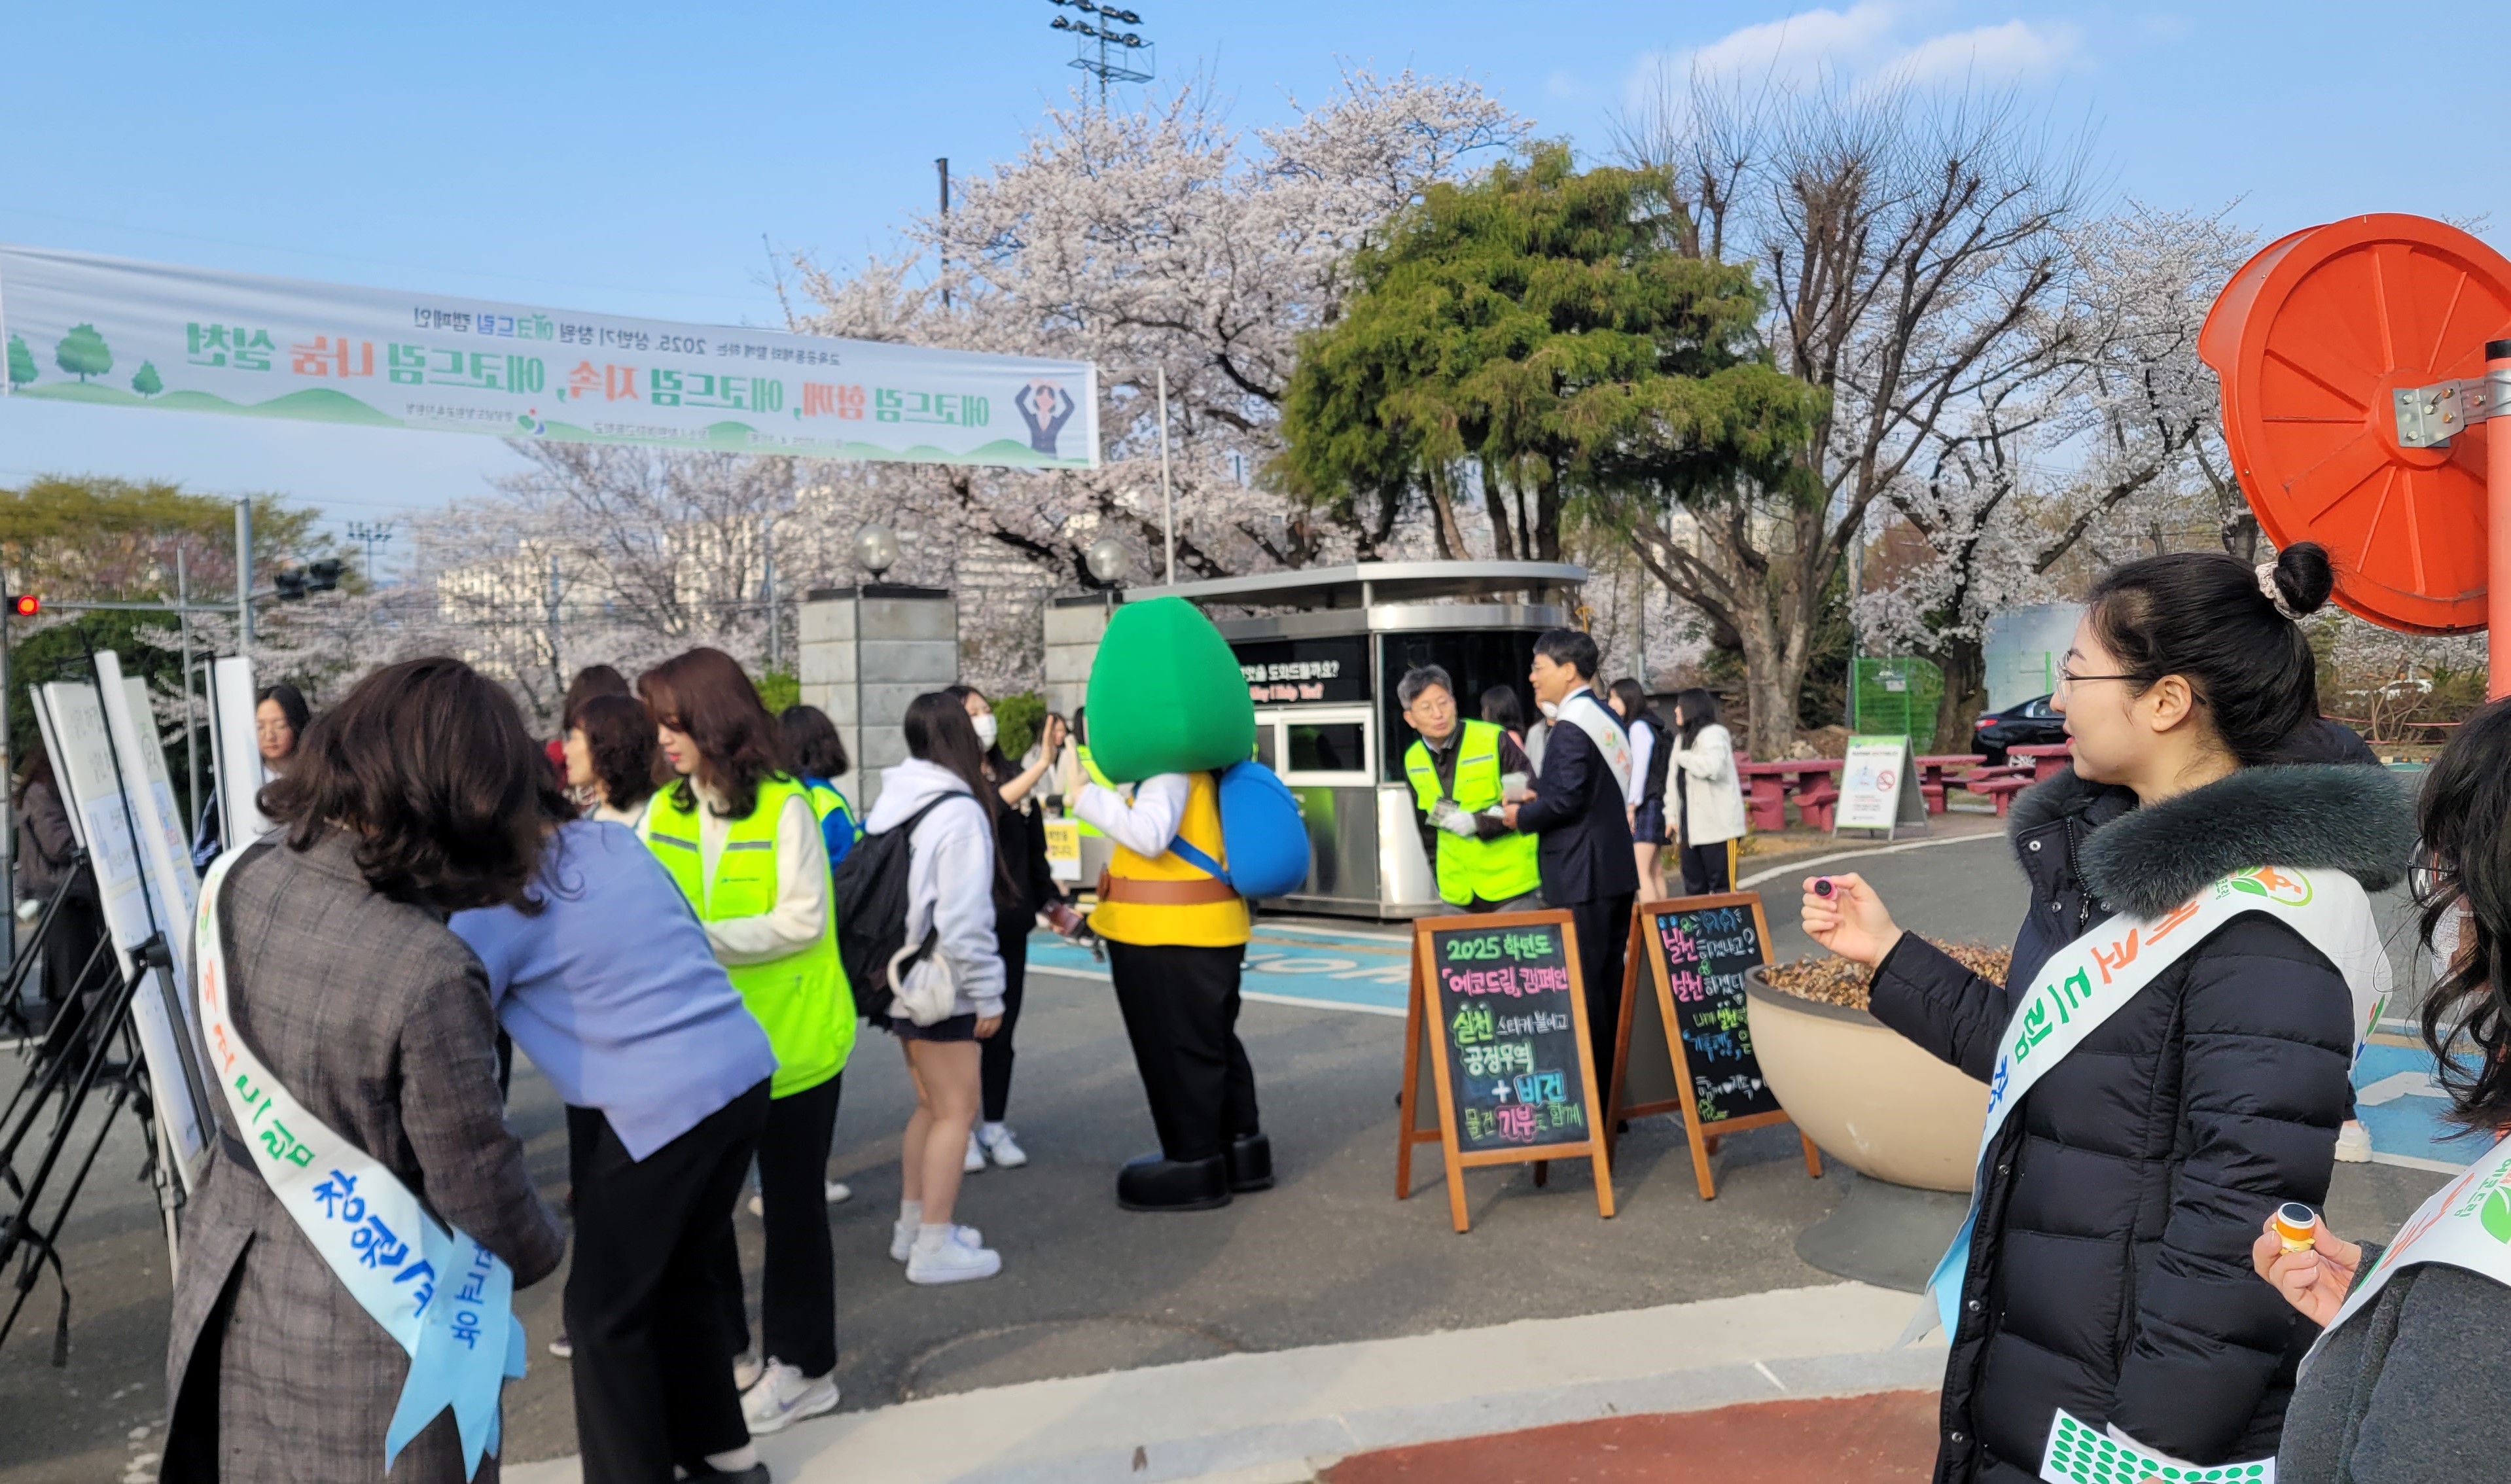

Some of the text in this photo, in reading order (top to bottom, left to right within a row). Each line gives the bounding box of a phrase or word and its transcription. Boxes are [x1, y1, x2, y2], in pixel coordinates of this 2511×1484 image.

[1240, 664, 1268, 682] 엇을
[1446, 933, 1553, 962] 2025 학년도
[1518, 965, 1569, 995] 캠페인
[1452, 1009, 1495, 1045] 실천
[1463, 1042, 1535, 1077] 공정무역
[1516, 1071, 1566, 1104] 비건
[1465, 1105, 1497, 1141] 물건
[1547, 1102, 1584, 1128] 함께
